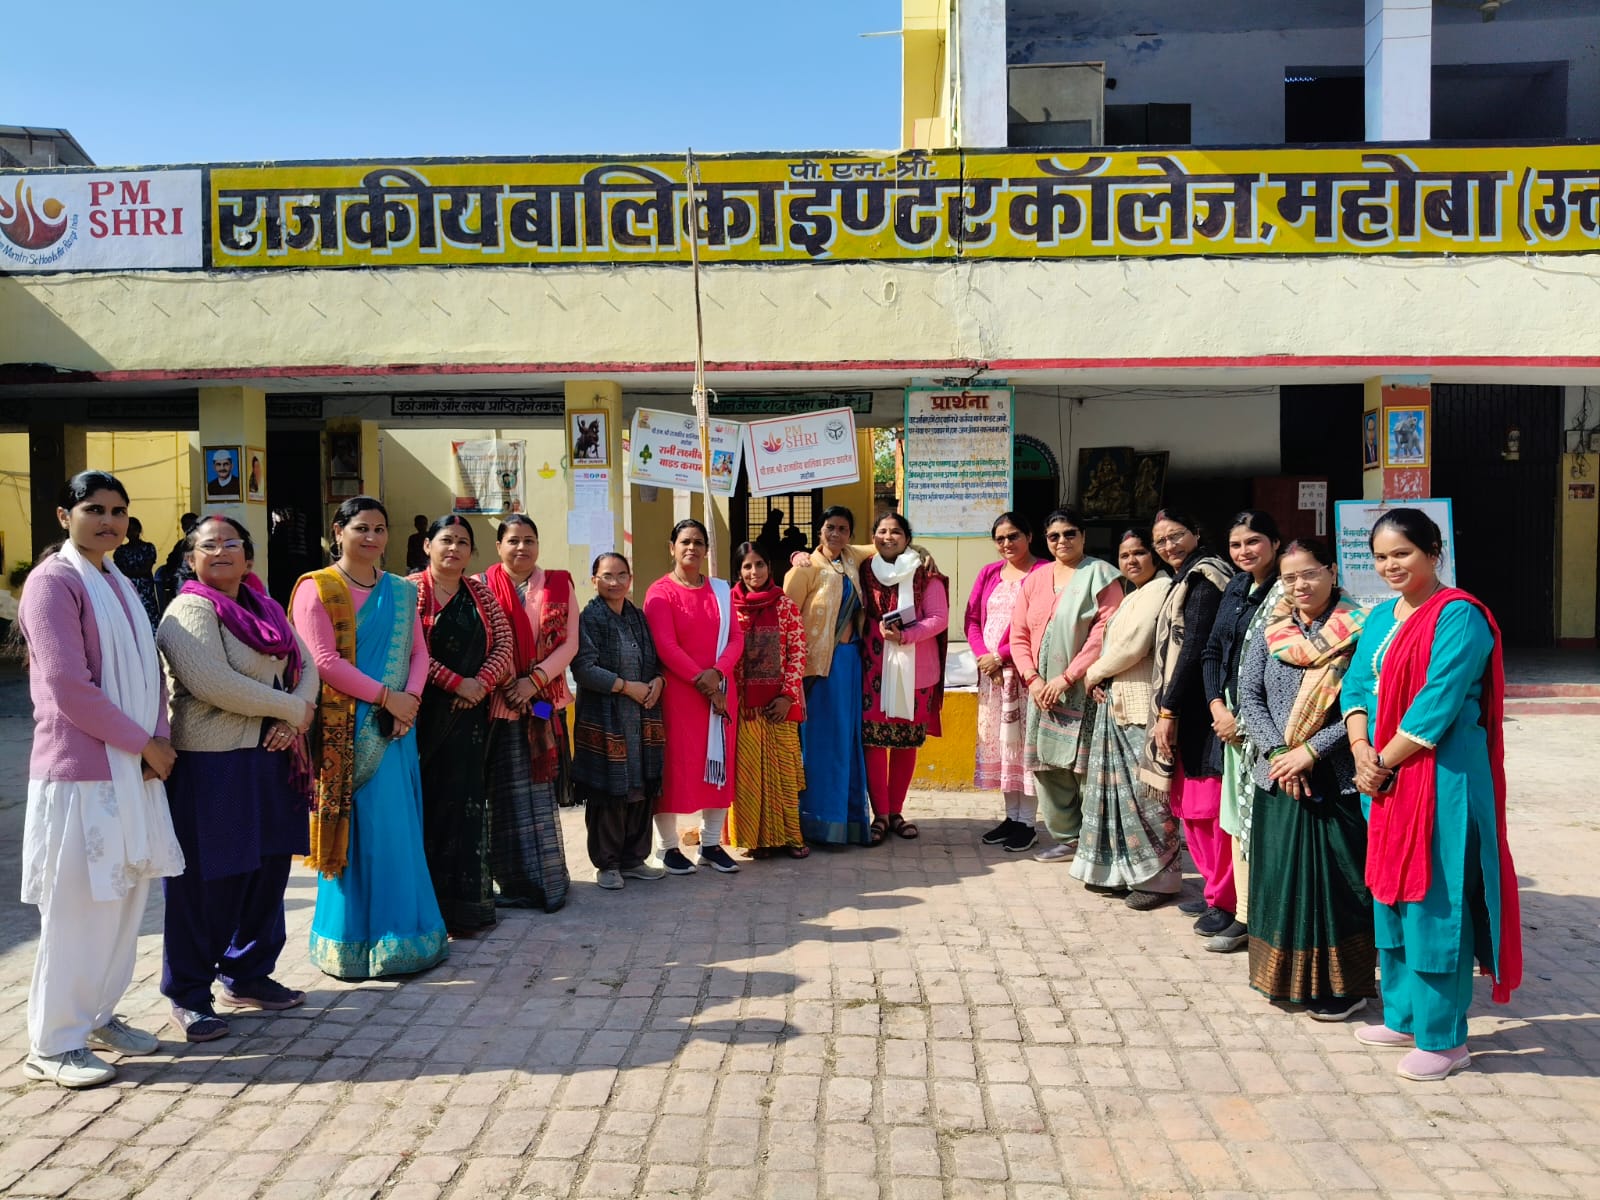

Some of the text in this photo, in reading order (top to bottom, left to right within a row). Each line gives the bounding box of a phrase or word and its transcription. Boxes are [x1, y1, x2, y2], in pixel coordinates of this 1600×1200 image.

[88, 179, 151, 207] PM
[217, 168, 507, 254] राजकीय
[508, 164, 785, 252] बालिका
[785, 178, 1006, 258] इण्टर
[1266, 152, 1512, 243] महोबा
[88, 207, 184, 239] SHRI
[930, 391, 990, 411] प्रार्थना
[659, 444, 676, 455] रानी
[785, 432, 819, 449] SHRI
